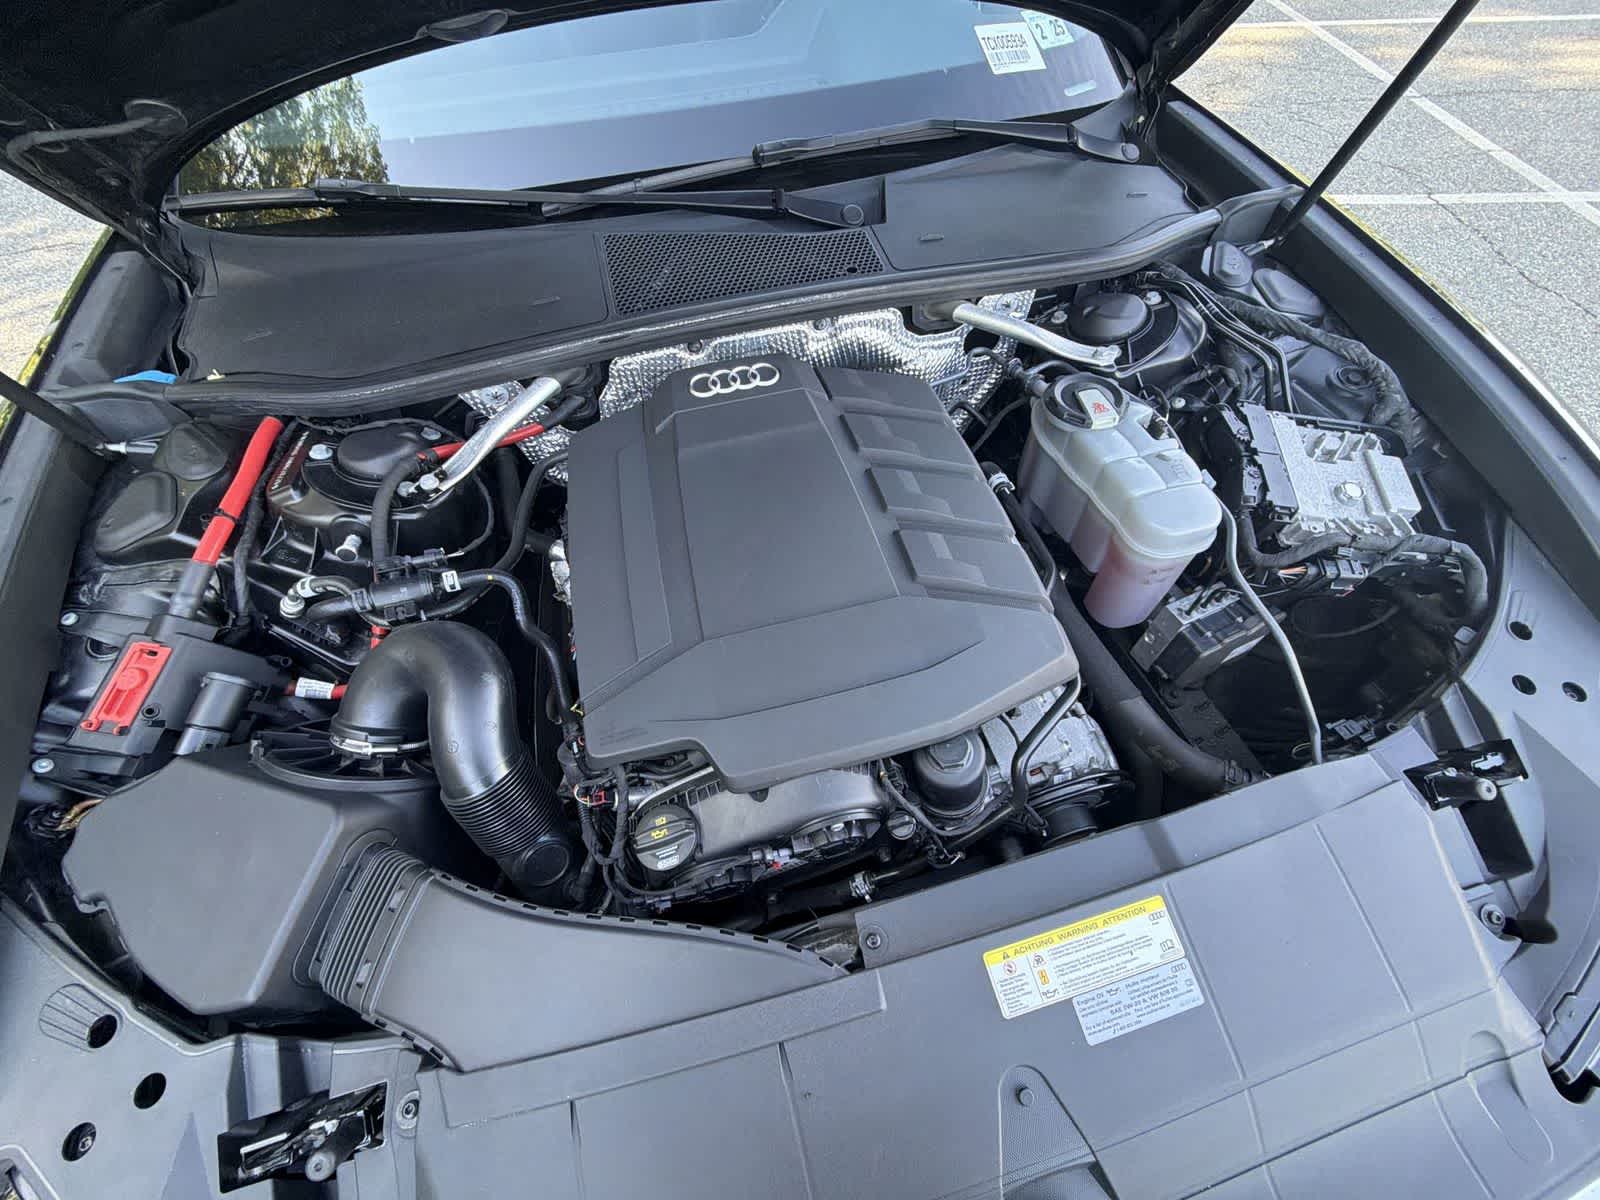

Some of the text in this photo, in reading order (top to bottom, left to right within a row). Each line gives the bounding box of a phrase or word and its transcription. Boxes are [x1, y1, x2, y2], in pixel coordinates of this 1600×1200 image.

[1013, 936, 1054, 956] ACHTUNG
[1057, 922, 1099, 941] WARNING
[1102, 906, 1147, 927] ATTENTION
